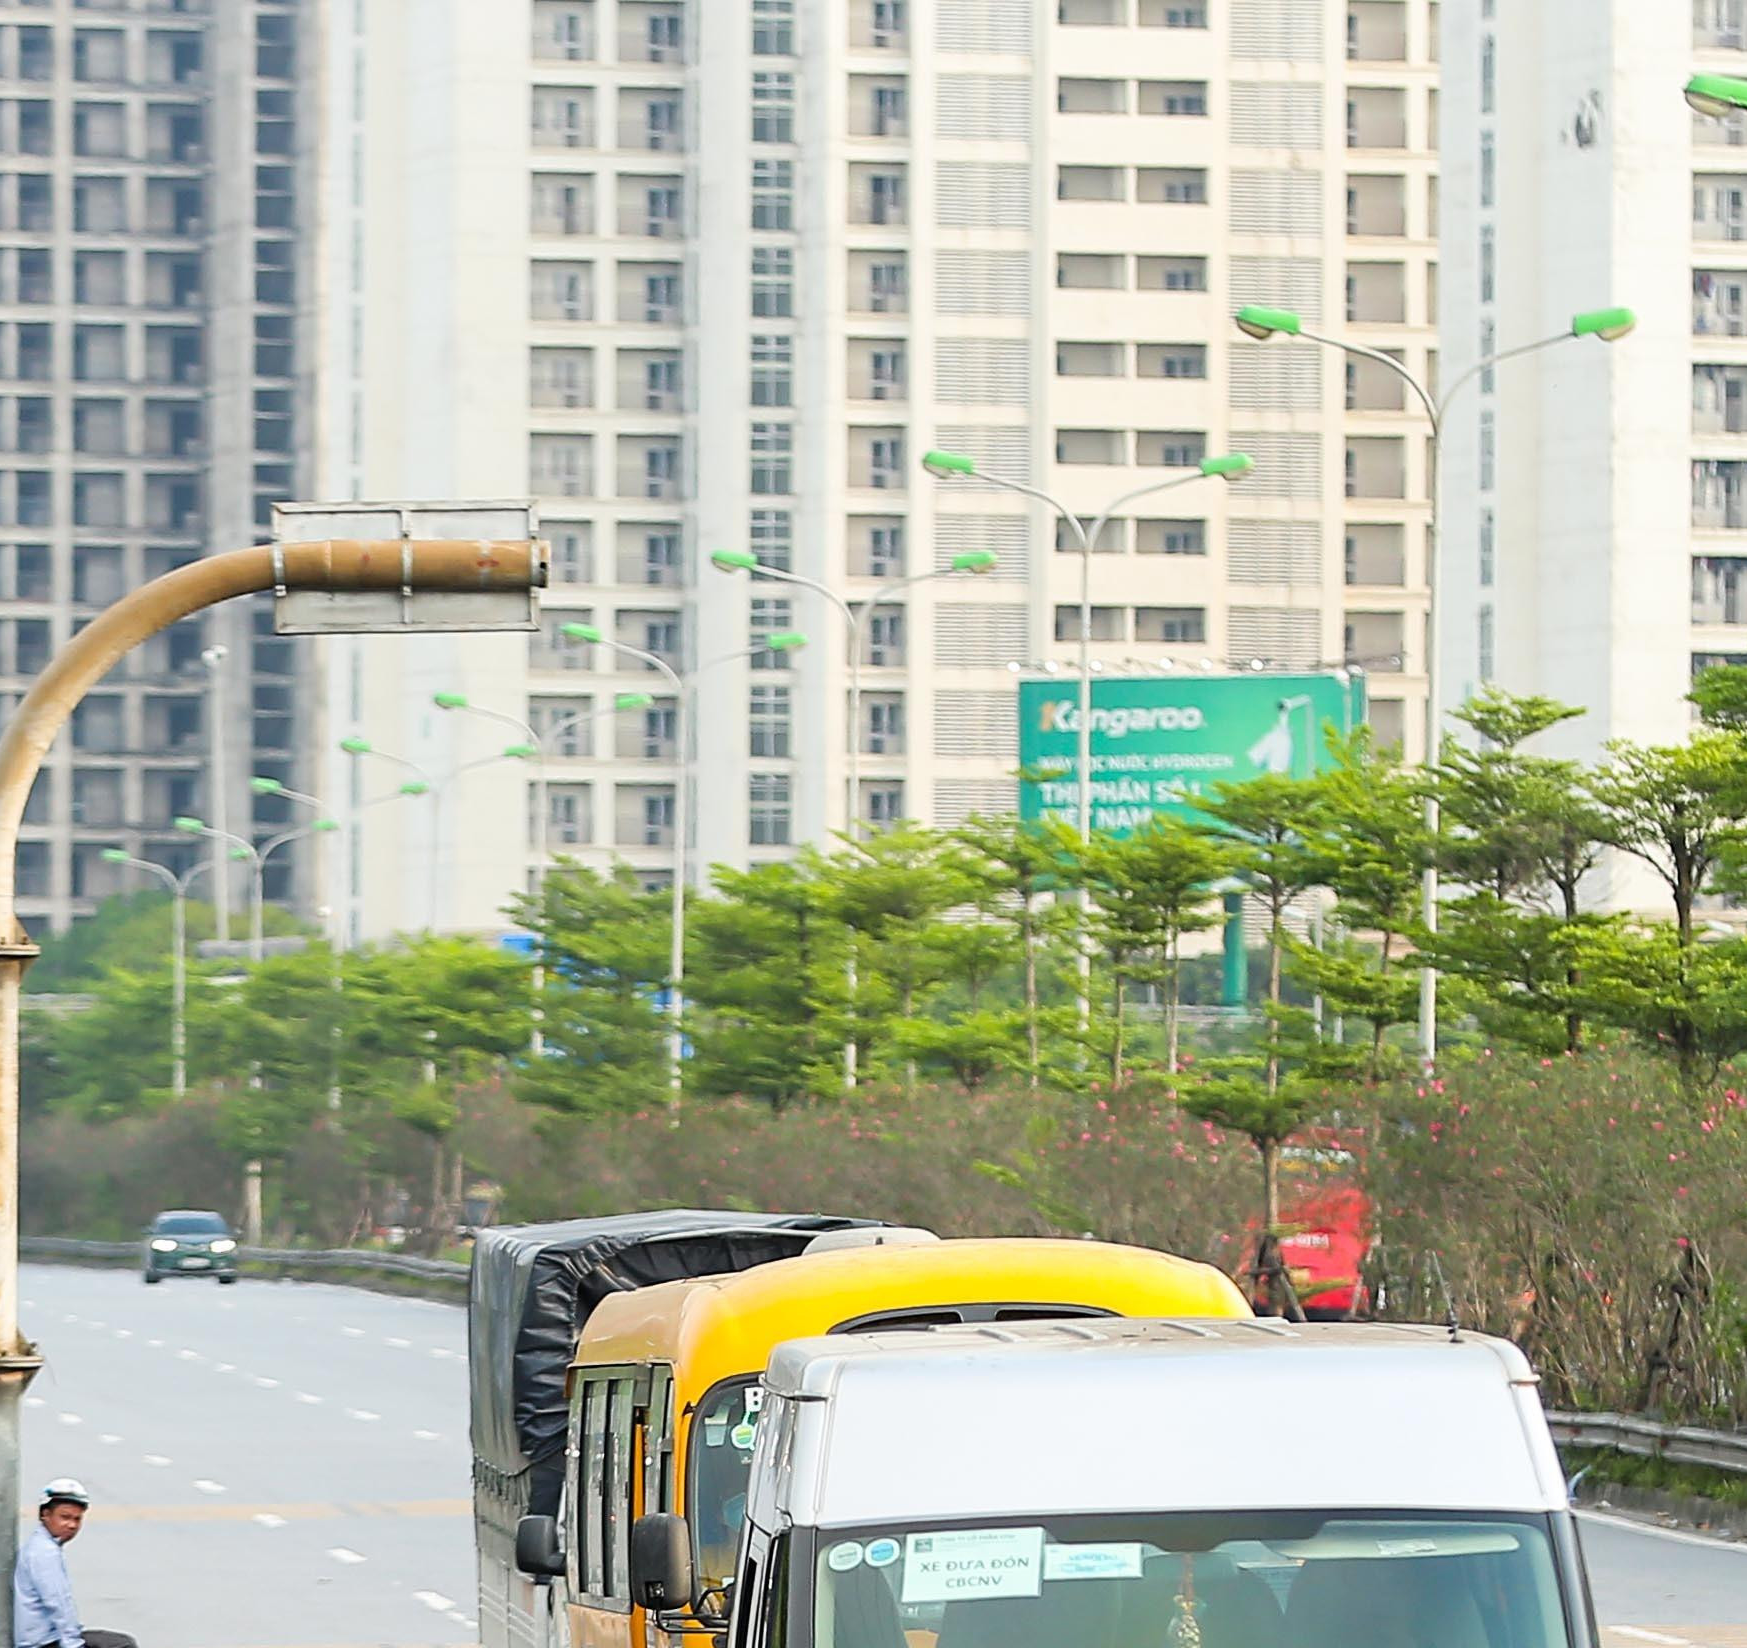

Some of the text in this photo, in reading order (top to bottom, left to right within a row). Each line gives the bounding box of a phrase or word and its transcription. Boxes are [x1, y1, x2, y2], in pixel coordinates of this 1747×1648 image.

[1040, 700, 1204, 738] Kangaroo
[920, 1555, 1030, 1574] XE ĐƯA ĐÓN
[945, 1575, 1003, 1589] CBCNV
